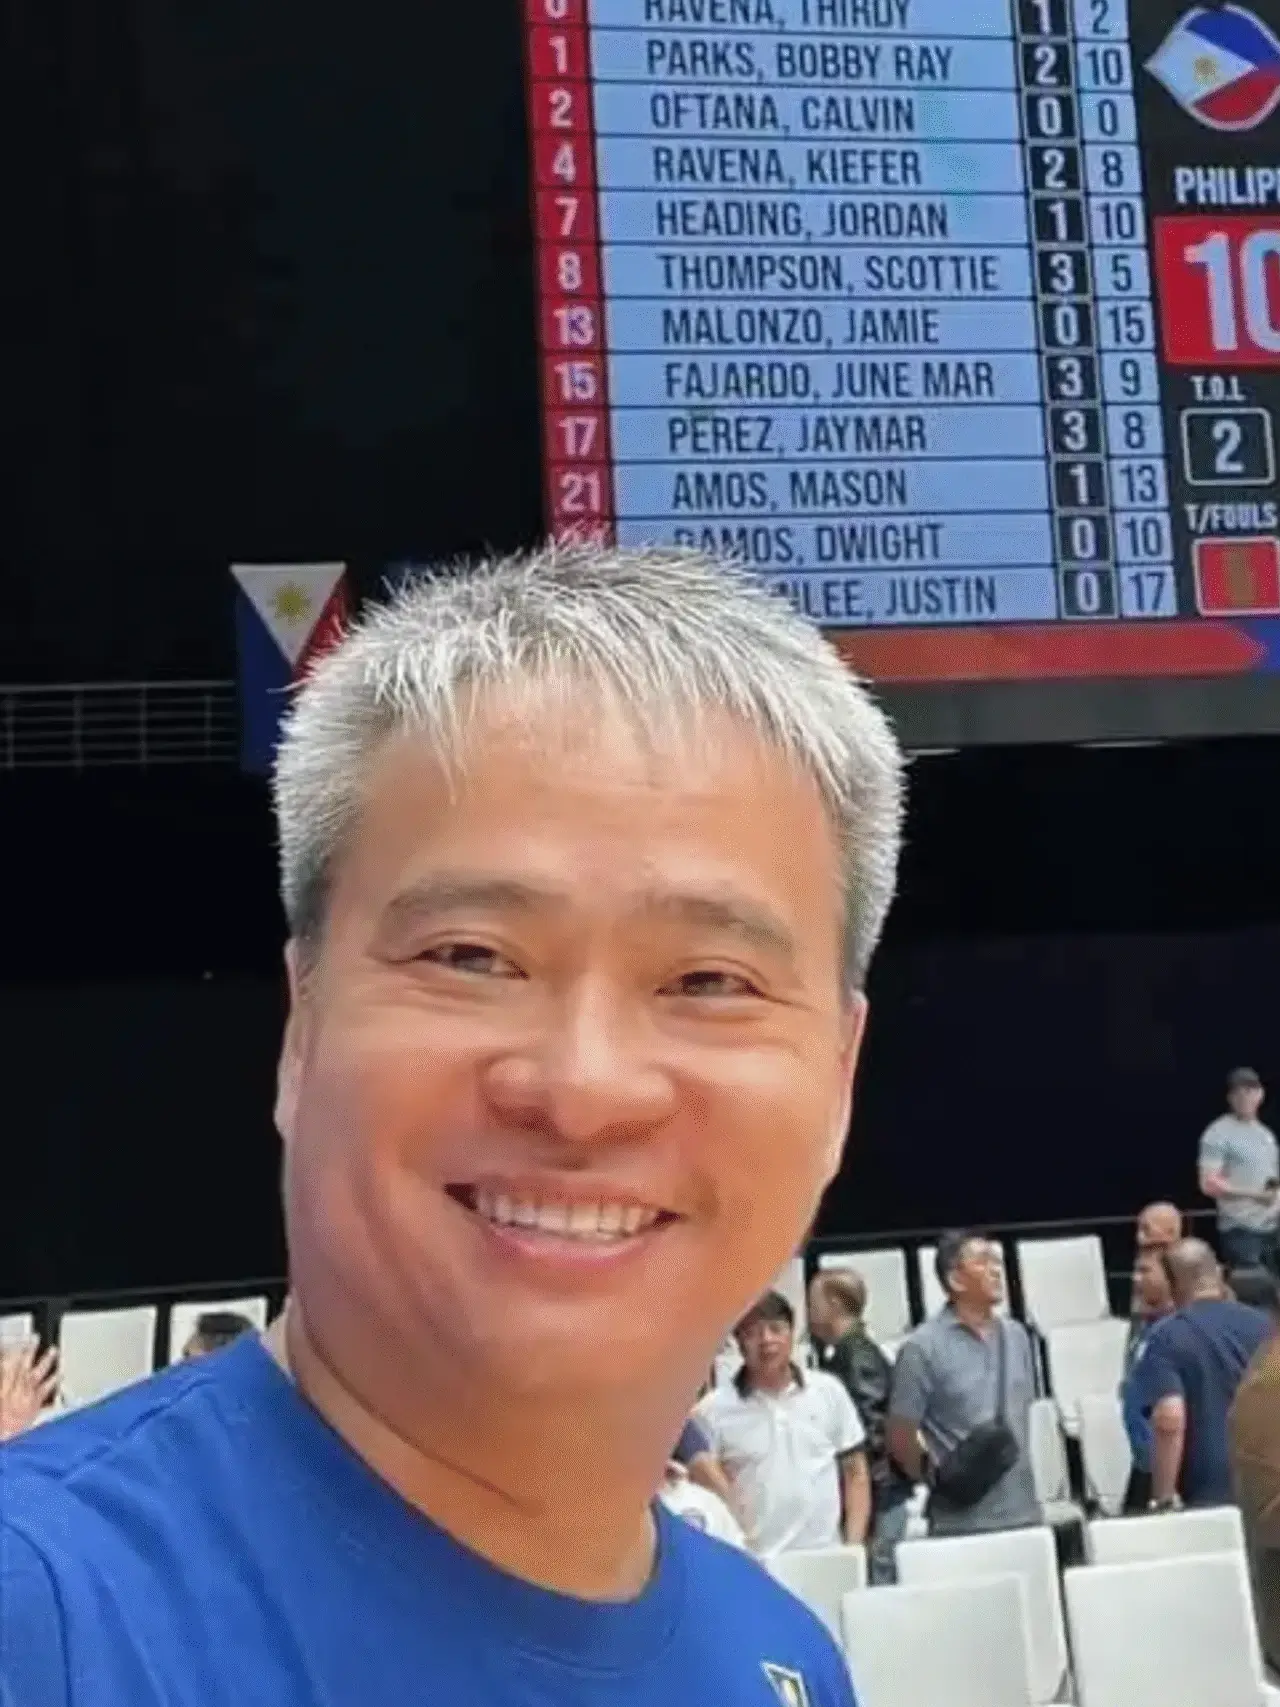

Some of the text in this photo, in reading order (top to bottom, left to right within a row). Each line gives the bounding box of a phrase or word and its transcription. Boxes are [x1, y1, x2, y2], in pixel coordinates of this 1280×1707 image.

[1090, 0, 1111, 35] 2
[549, 36, 1123, 86] 1 PARKS, BOBBY RAY 2 10
[549, 89, 1119, 138] 2 OFTANA, CALVIN 0 0
[553, 142, 1124, 190] 4 RAVENA, KIEFER 2 8
[554, 198, 1136, 242] 7 HEADING, JORDAN 1 10
[558, 252, 1132, 293] 8 THOMPSON, SCOTTIE 3 5
[553, 306, 1145, 348] 13 MALONZO, JAMIE 0 15
[554, 358, 1141, 401] 15 FAJARDO, JUNE MAR 3 9
[559, 411, 1146, 458] 17 PEREZ, JAYMAR 3 8
[1212, 418, 1245, 474] 2
[558, 464, 1158, 512] 21 AMOS, MASON 1 13
[816, 522, 945, 562] DWIGHT
[1071, 518, 1095, 559] 0
[1125, 517, 1161, 557] 10
[1184, 503, 1279, 533] T/FOULS
[886, 571, 998, 617] JUSTIN
[1075, 572, 1099, 613] 0
[1129, 571, 1167, 614] 17
